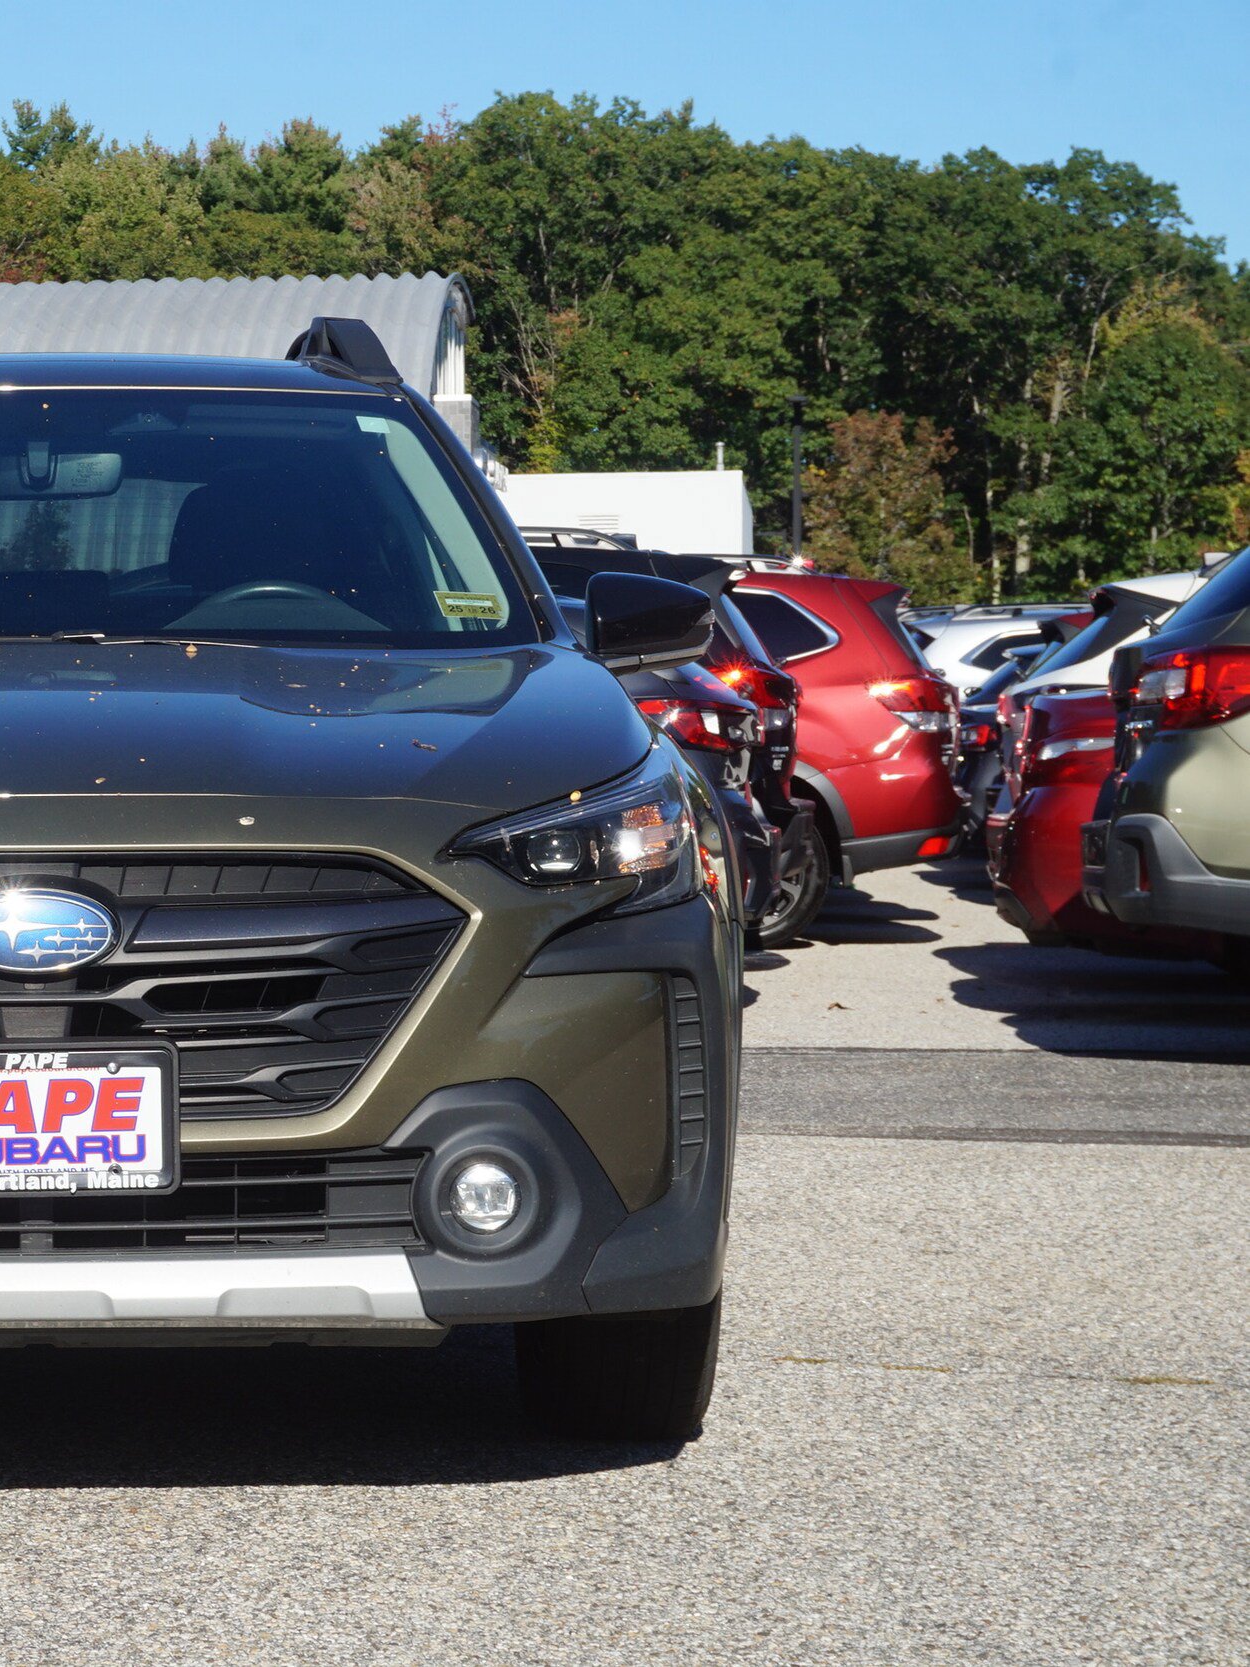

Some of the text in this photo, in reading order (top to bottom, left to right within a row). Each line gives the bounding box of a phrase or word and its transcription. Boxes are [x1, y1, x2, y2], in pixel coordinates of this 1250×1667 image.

[448, 605, 463, 613] 25
[479, 606, 495, 614] 26
[5, 1052, 70, 1070] PAPE
[87, 1171, 160, 1189] Maine
